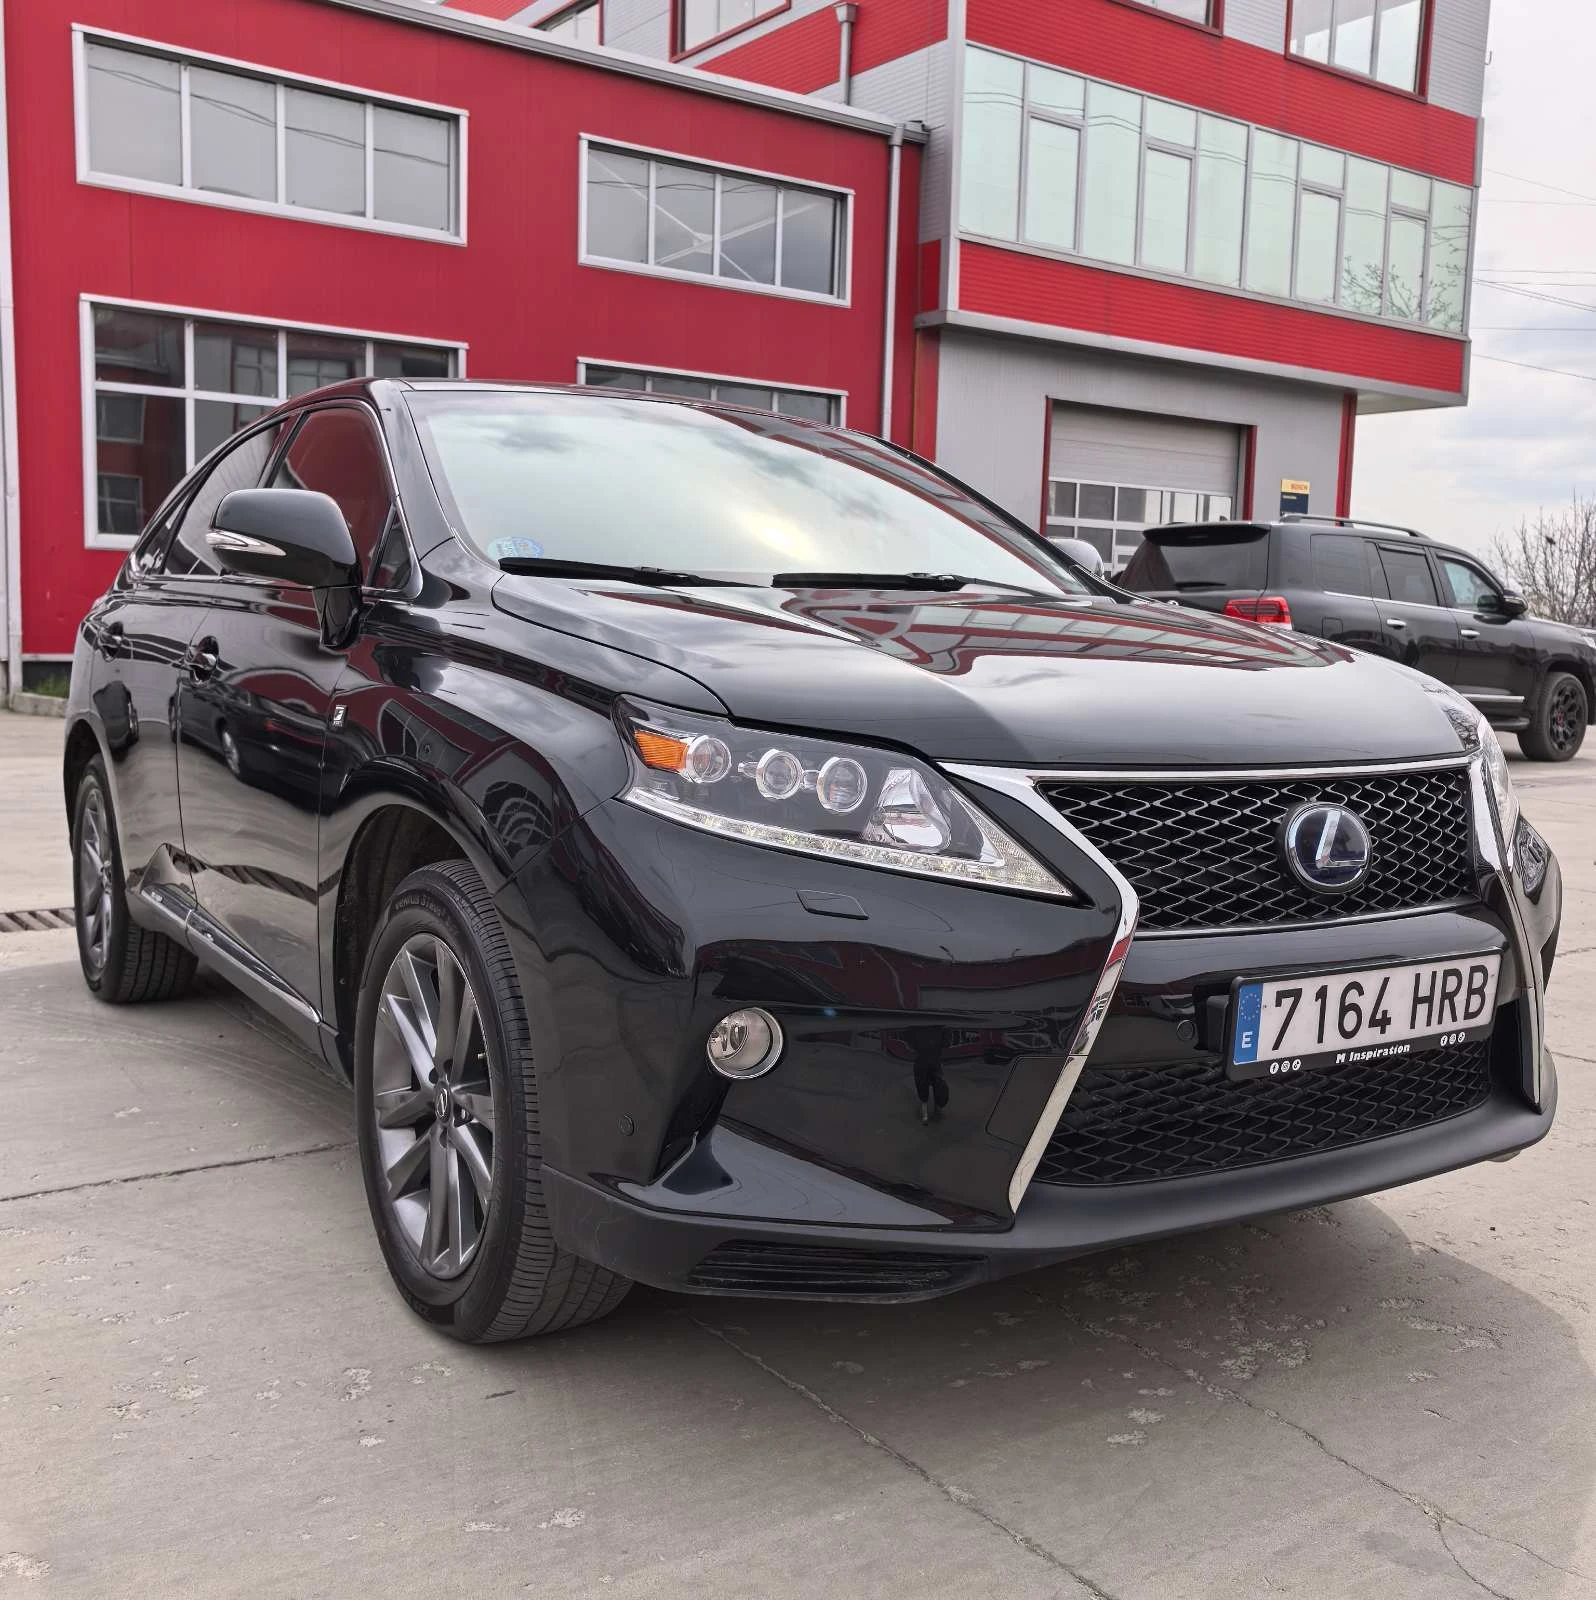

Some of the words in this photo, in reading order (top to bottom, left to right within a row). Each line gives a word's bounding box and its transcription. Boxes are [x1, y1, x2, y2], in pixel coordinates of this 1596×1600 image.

[1271, 976, 1392, 1051] 7164
[1409, 964, 1489, 1030] HRB
[1241, 1031, 1253, 1049] E
[1335, 1052, 1346, 1064] M
[1348, 1043, 1411, 1061] Inspiration
